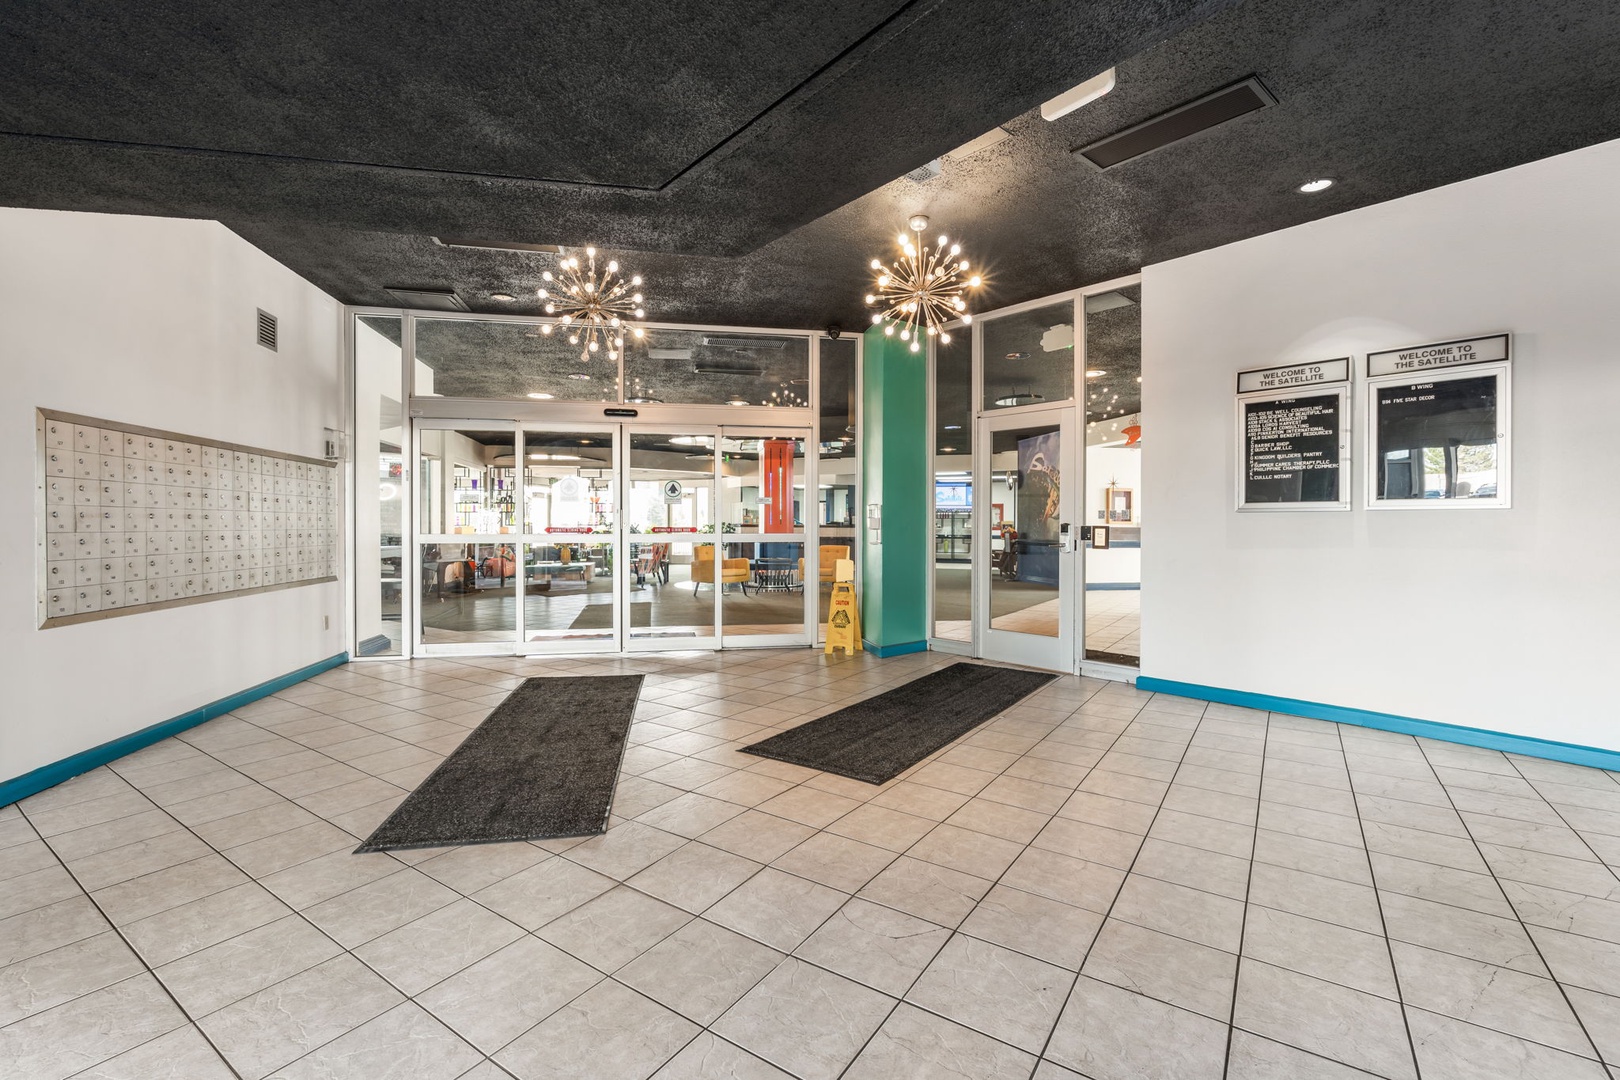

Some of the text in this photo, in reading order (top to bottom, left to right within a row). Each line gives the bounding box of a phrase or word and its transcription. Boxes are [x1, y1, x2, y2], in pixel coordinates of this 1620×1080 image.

[1399, 345, 1472, 361] WELCOME TO
[1395, 353, 1477, 369] THE SATELLITE
[1260, 373, 1323, 387] THE SATELLITE
[1263, 366, 1320, 380] WELCOME TO
